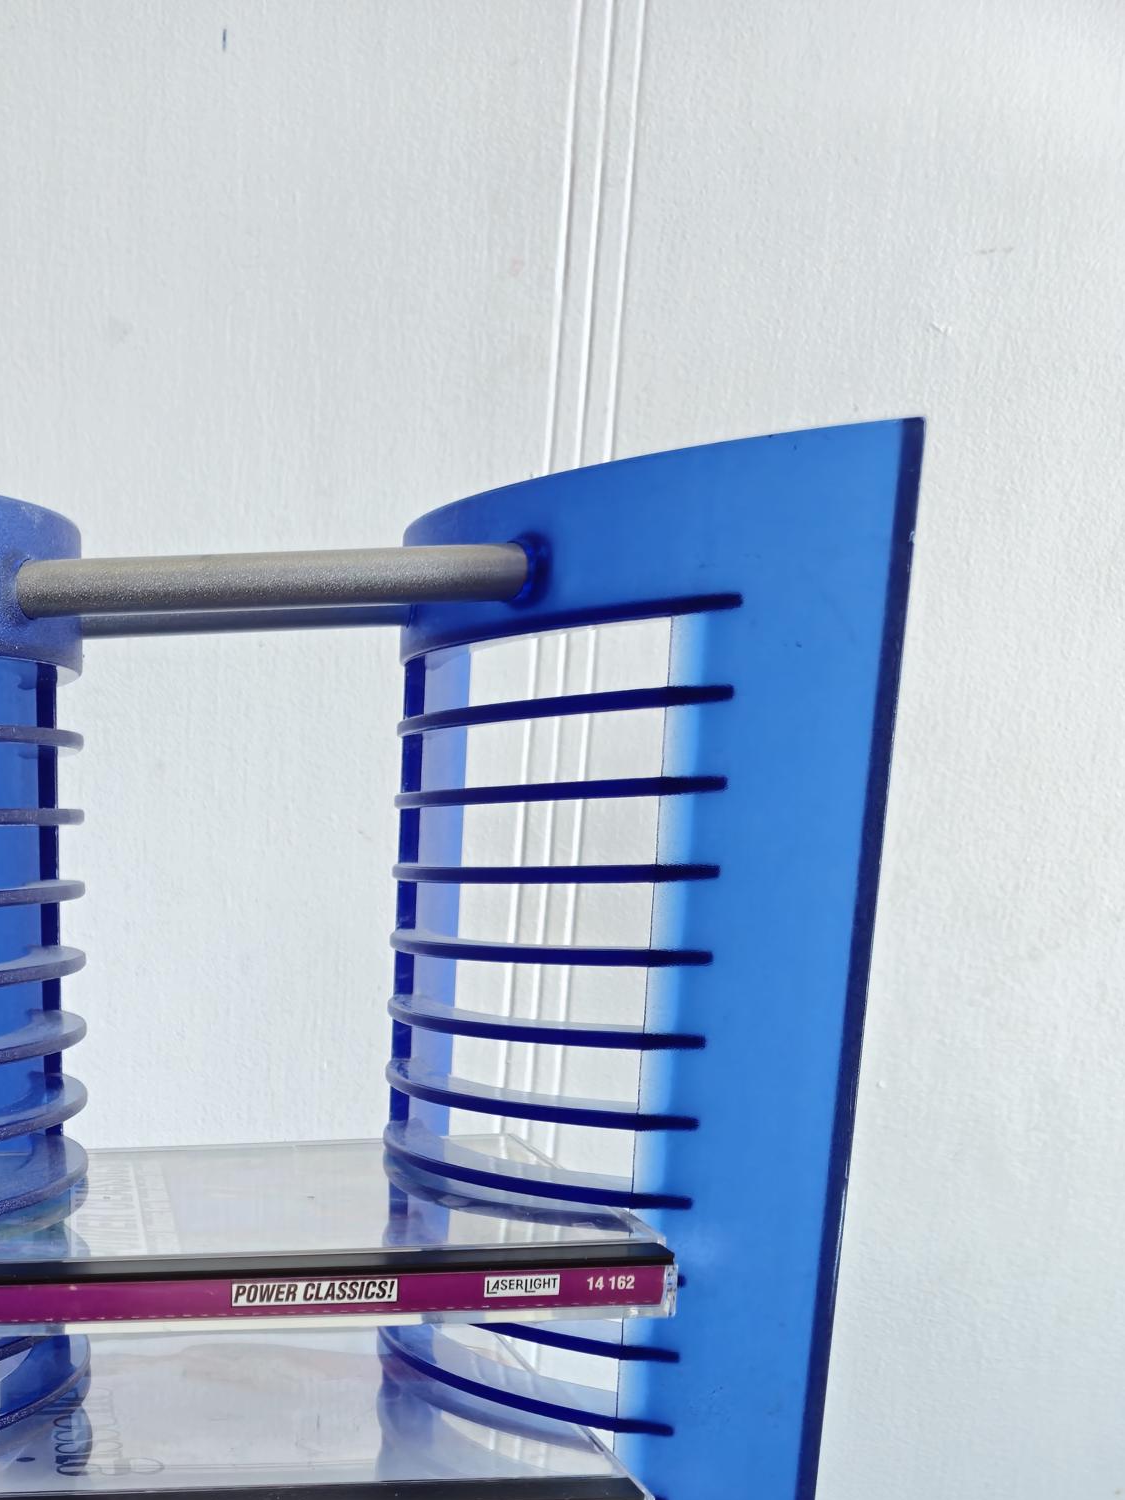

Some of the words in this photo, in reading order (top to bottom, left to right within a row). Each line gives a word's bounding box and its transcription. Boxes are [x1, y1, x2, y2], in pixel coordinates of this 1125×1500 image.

[486, 1277, 559, 1294] LASERLIGHT
[587, 1276, 604, 1291] 14
[609, 1275, 636, 1291] 162
[233, 1283, 298, 1304] POWER
[303, 1280, 395, 1301] CLASSICS!
